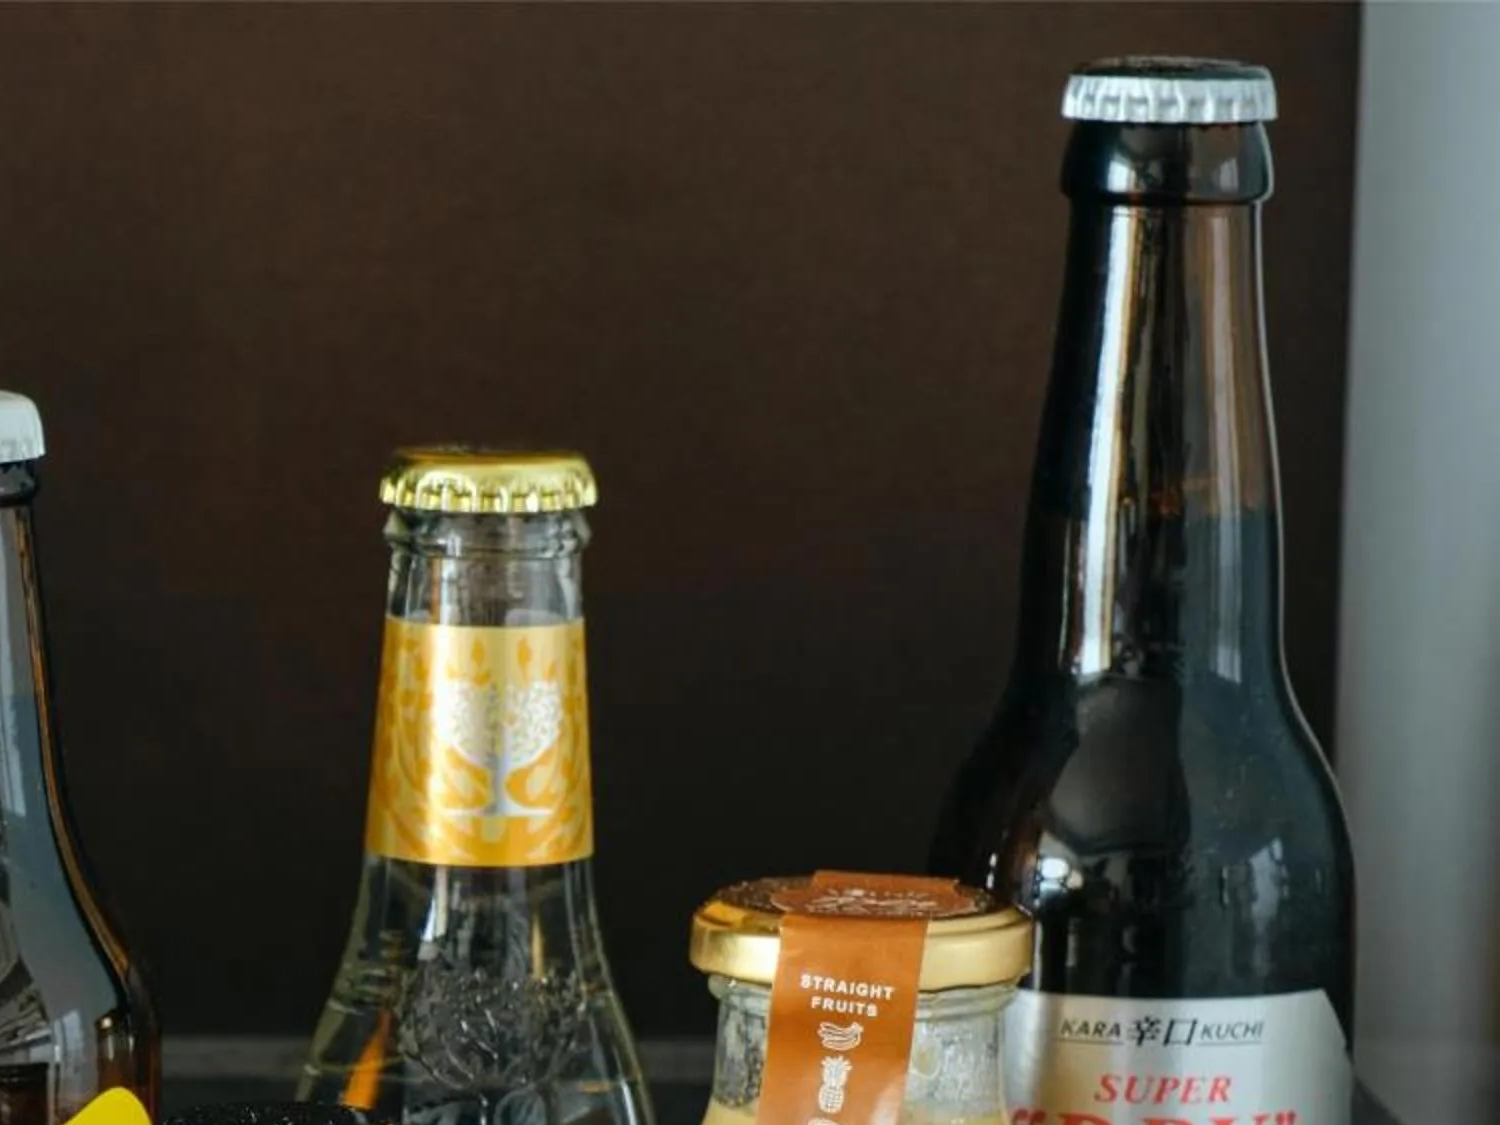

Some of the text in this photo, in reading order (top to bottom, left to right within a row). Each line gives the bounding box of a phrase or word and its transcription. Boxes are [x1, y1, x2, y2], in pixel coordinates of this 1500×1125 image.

[800, 974, 895, 1000] STRAIGHT
[810, 996, 878, 1017] FRUITS
[1060, 1019, 1122, 1039] KARA
[1200, 1020, 1266, 1040] KUCHI
[1094, 1074, 1233, 1104] SUPER
